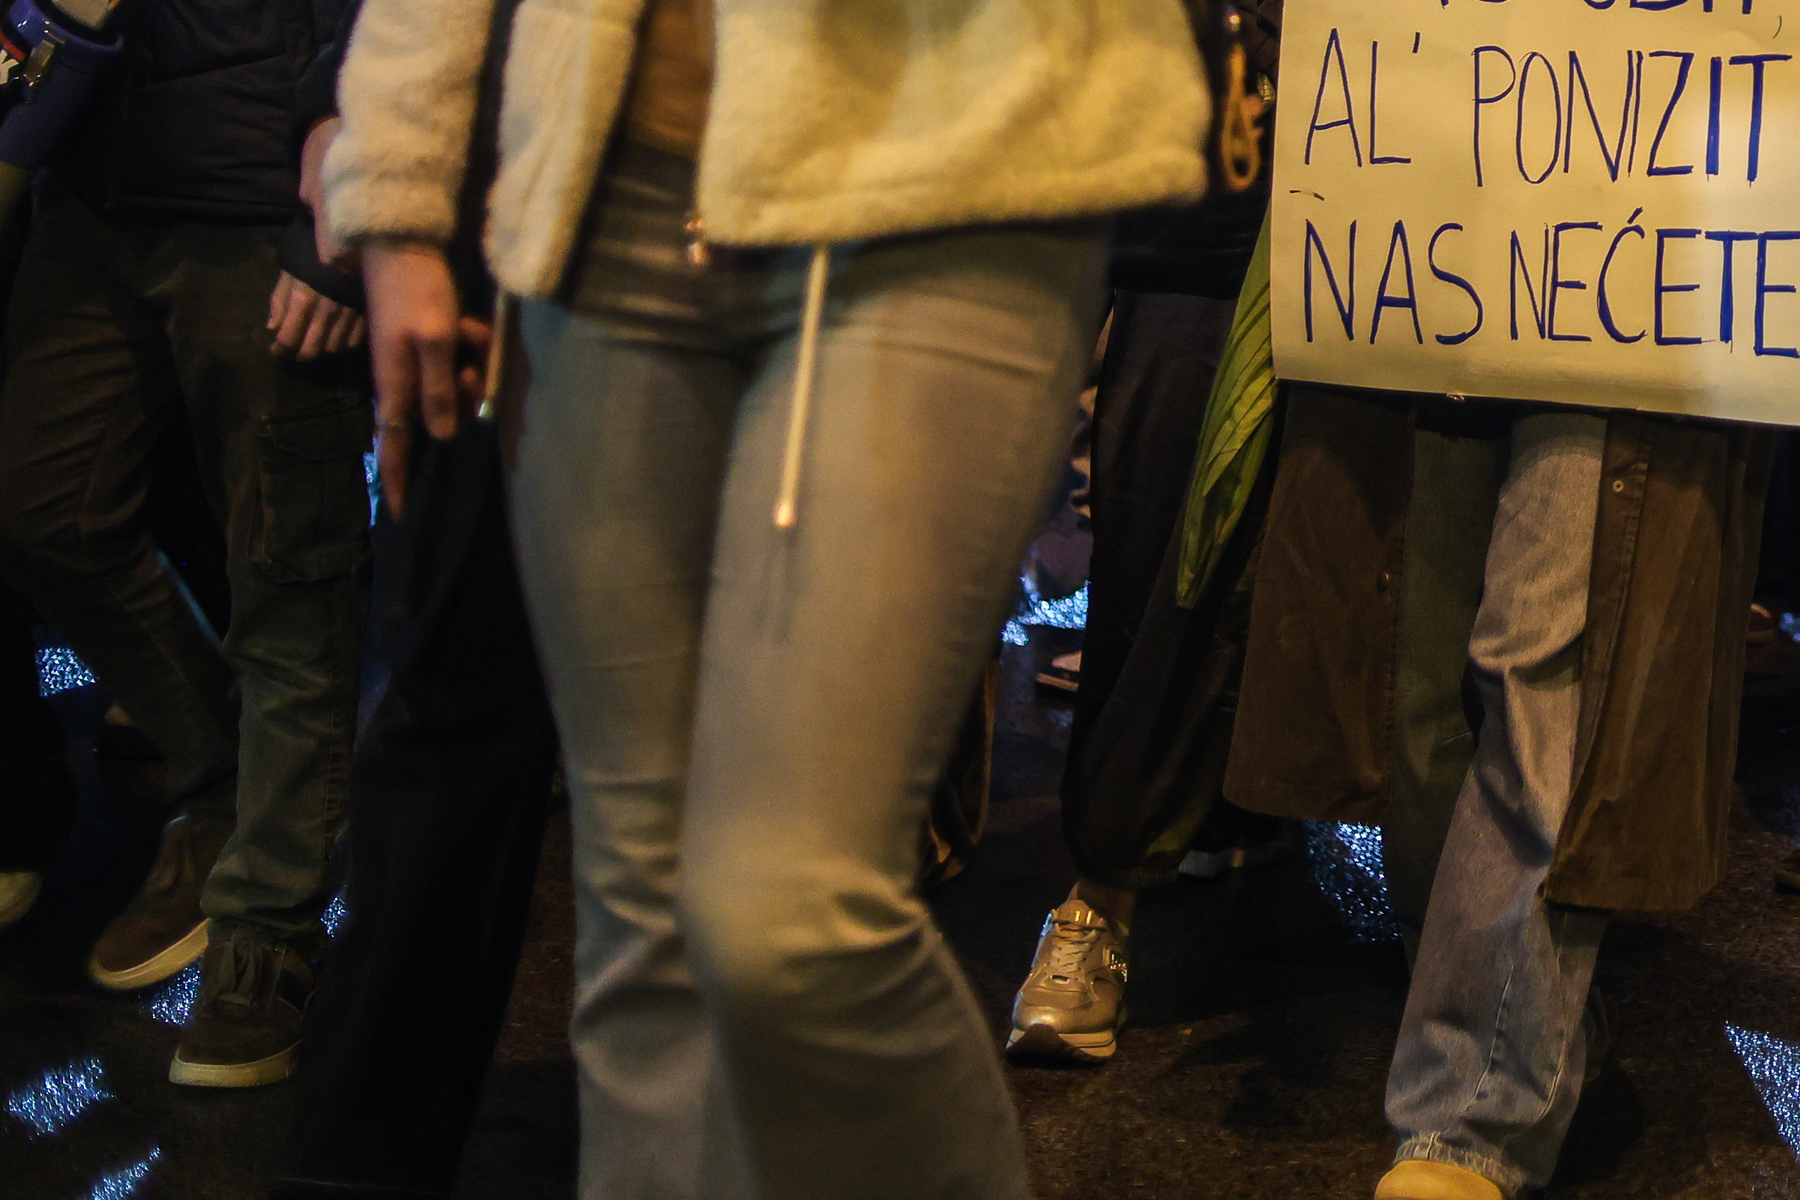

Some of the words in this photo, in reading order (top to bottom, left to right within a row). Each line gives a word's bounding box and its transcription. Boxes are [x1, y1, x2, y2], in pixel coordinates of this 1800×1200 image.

[1304, 28, 1421, 168] AL'
[1472, 45, 1793, 187] PONIZIT
[1303, 218, 1485, 346] NAS
